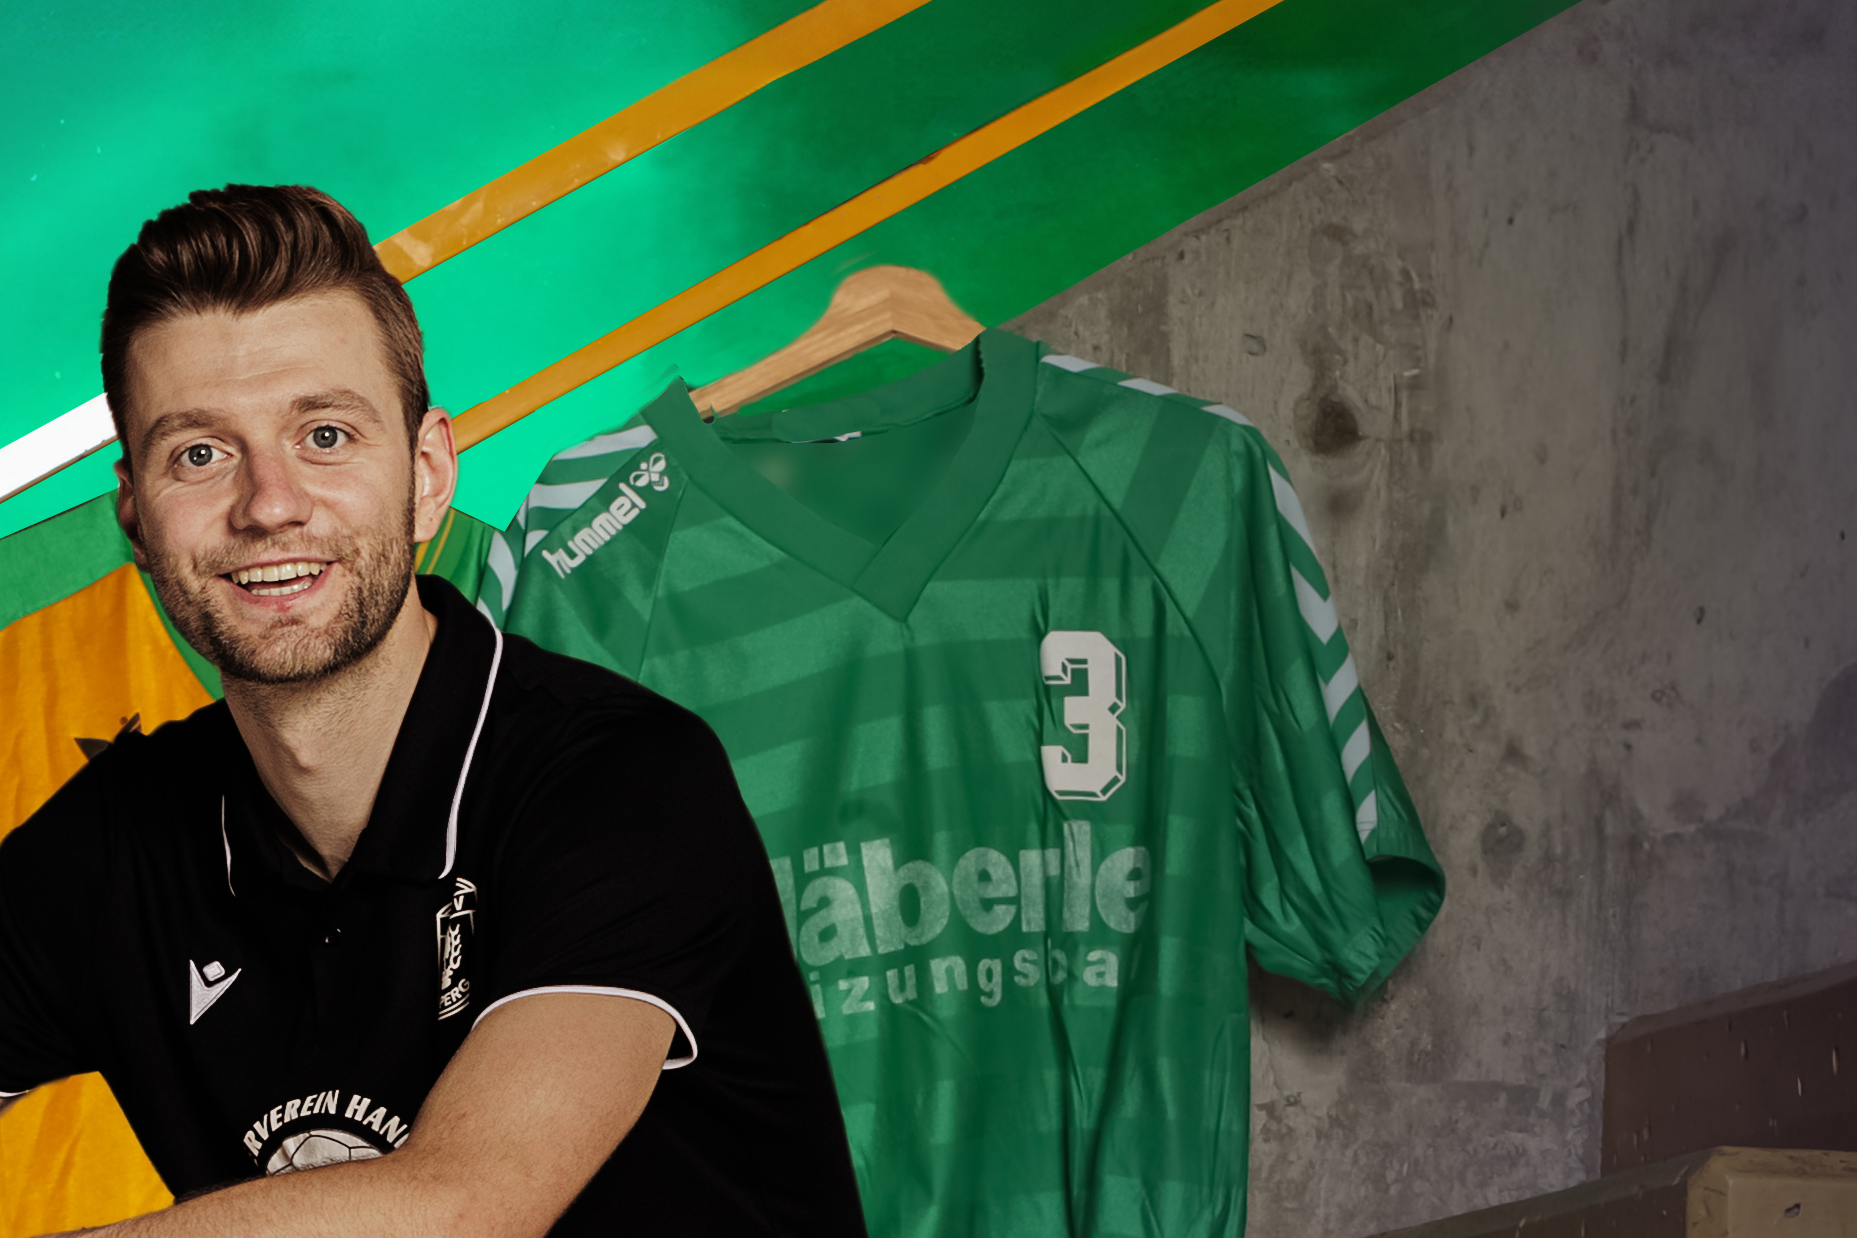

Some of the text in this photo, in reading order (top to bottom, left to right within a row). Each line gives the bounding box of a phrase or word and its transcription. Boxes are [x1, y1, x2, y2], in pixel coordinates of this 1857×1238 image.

[542, 482, 647, 580] hummel
[1040, 630, 1127, 801] 3
[243, 1090, 340, 1167] RVEREIN
